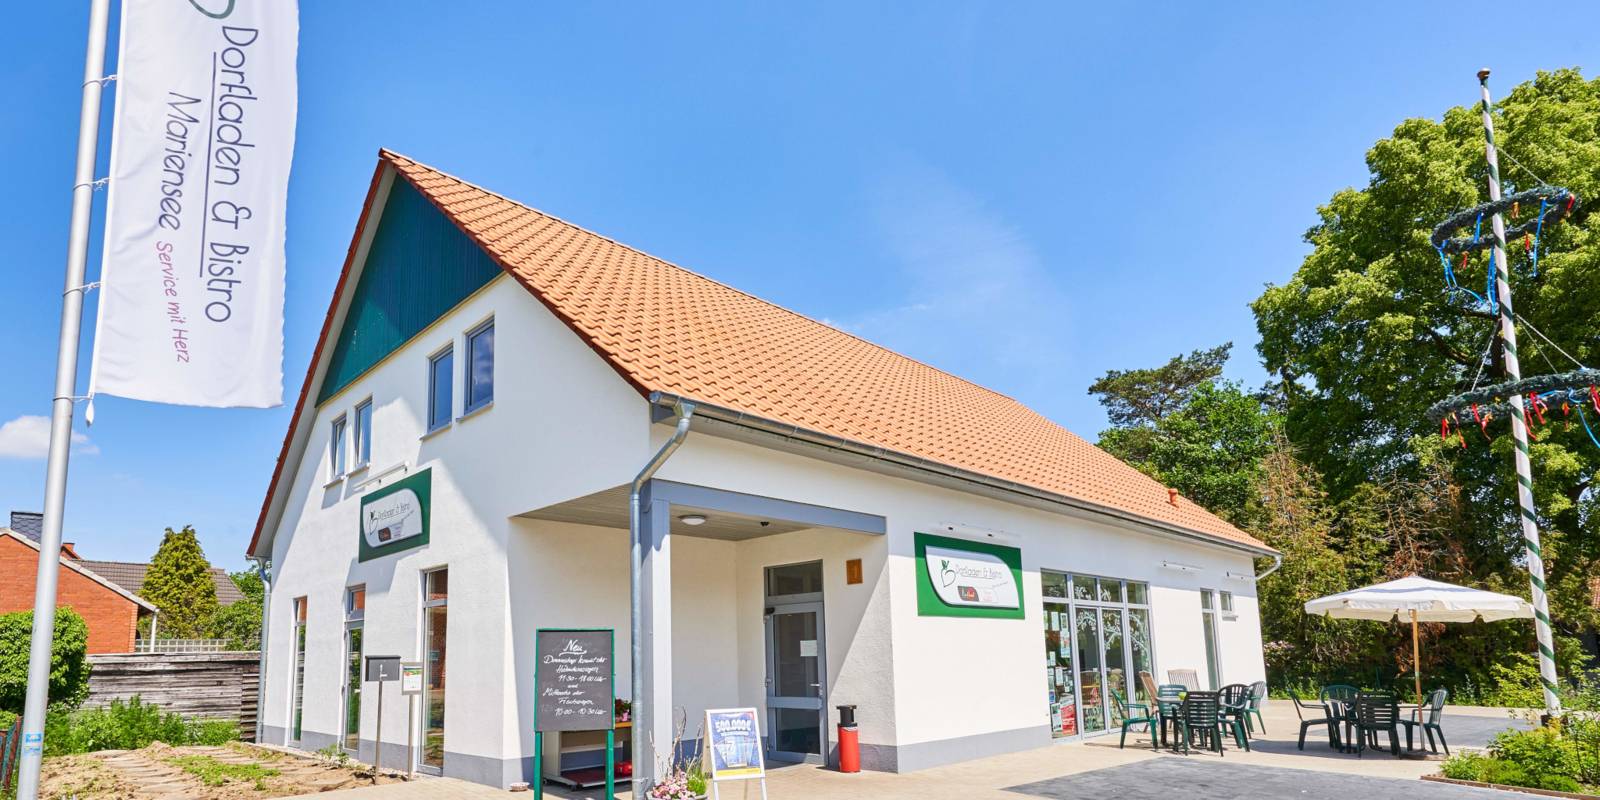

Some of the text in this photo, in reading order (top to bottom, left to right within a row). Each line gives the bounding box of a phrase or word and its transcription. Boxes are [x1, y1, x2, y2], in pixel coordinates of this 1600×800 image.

[156, 91, 202, 363] Mariensee Service mit Herz
[205, 25, 258, 323] Dorfladen & Bistro
[563, 639, 583, 652] Neu
